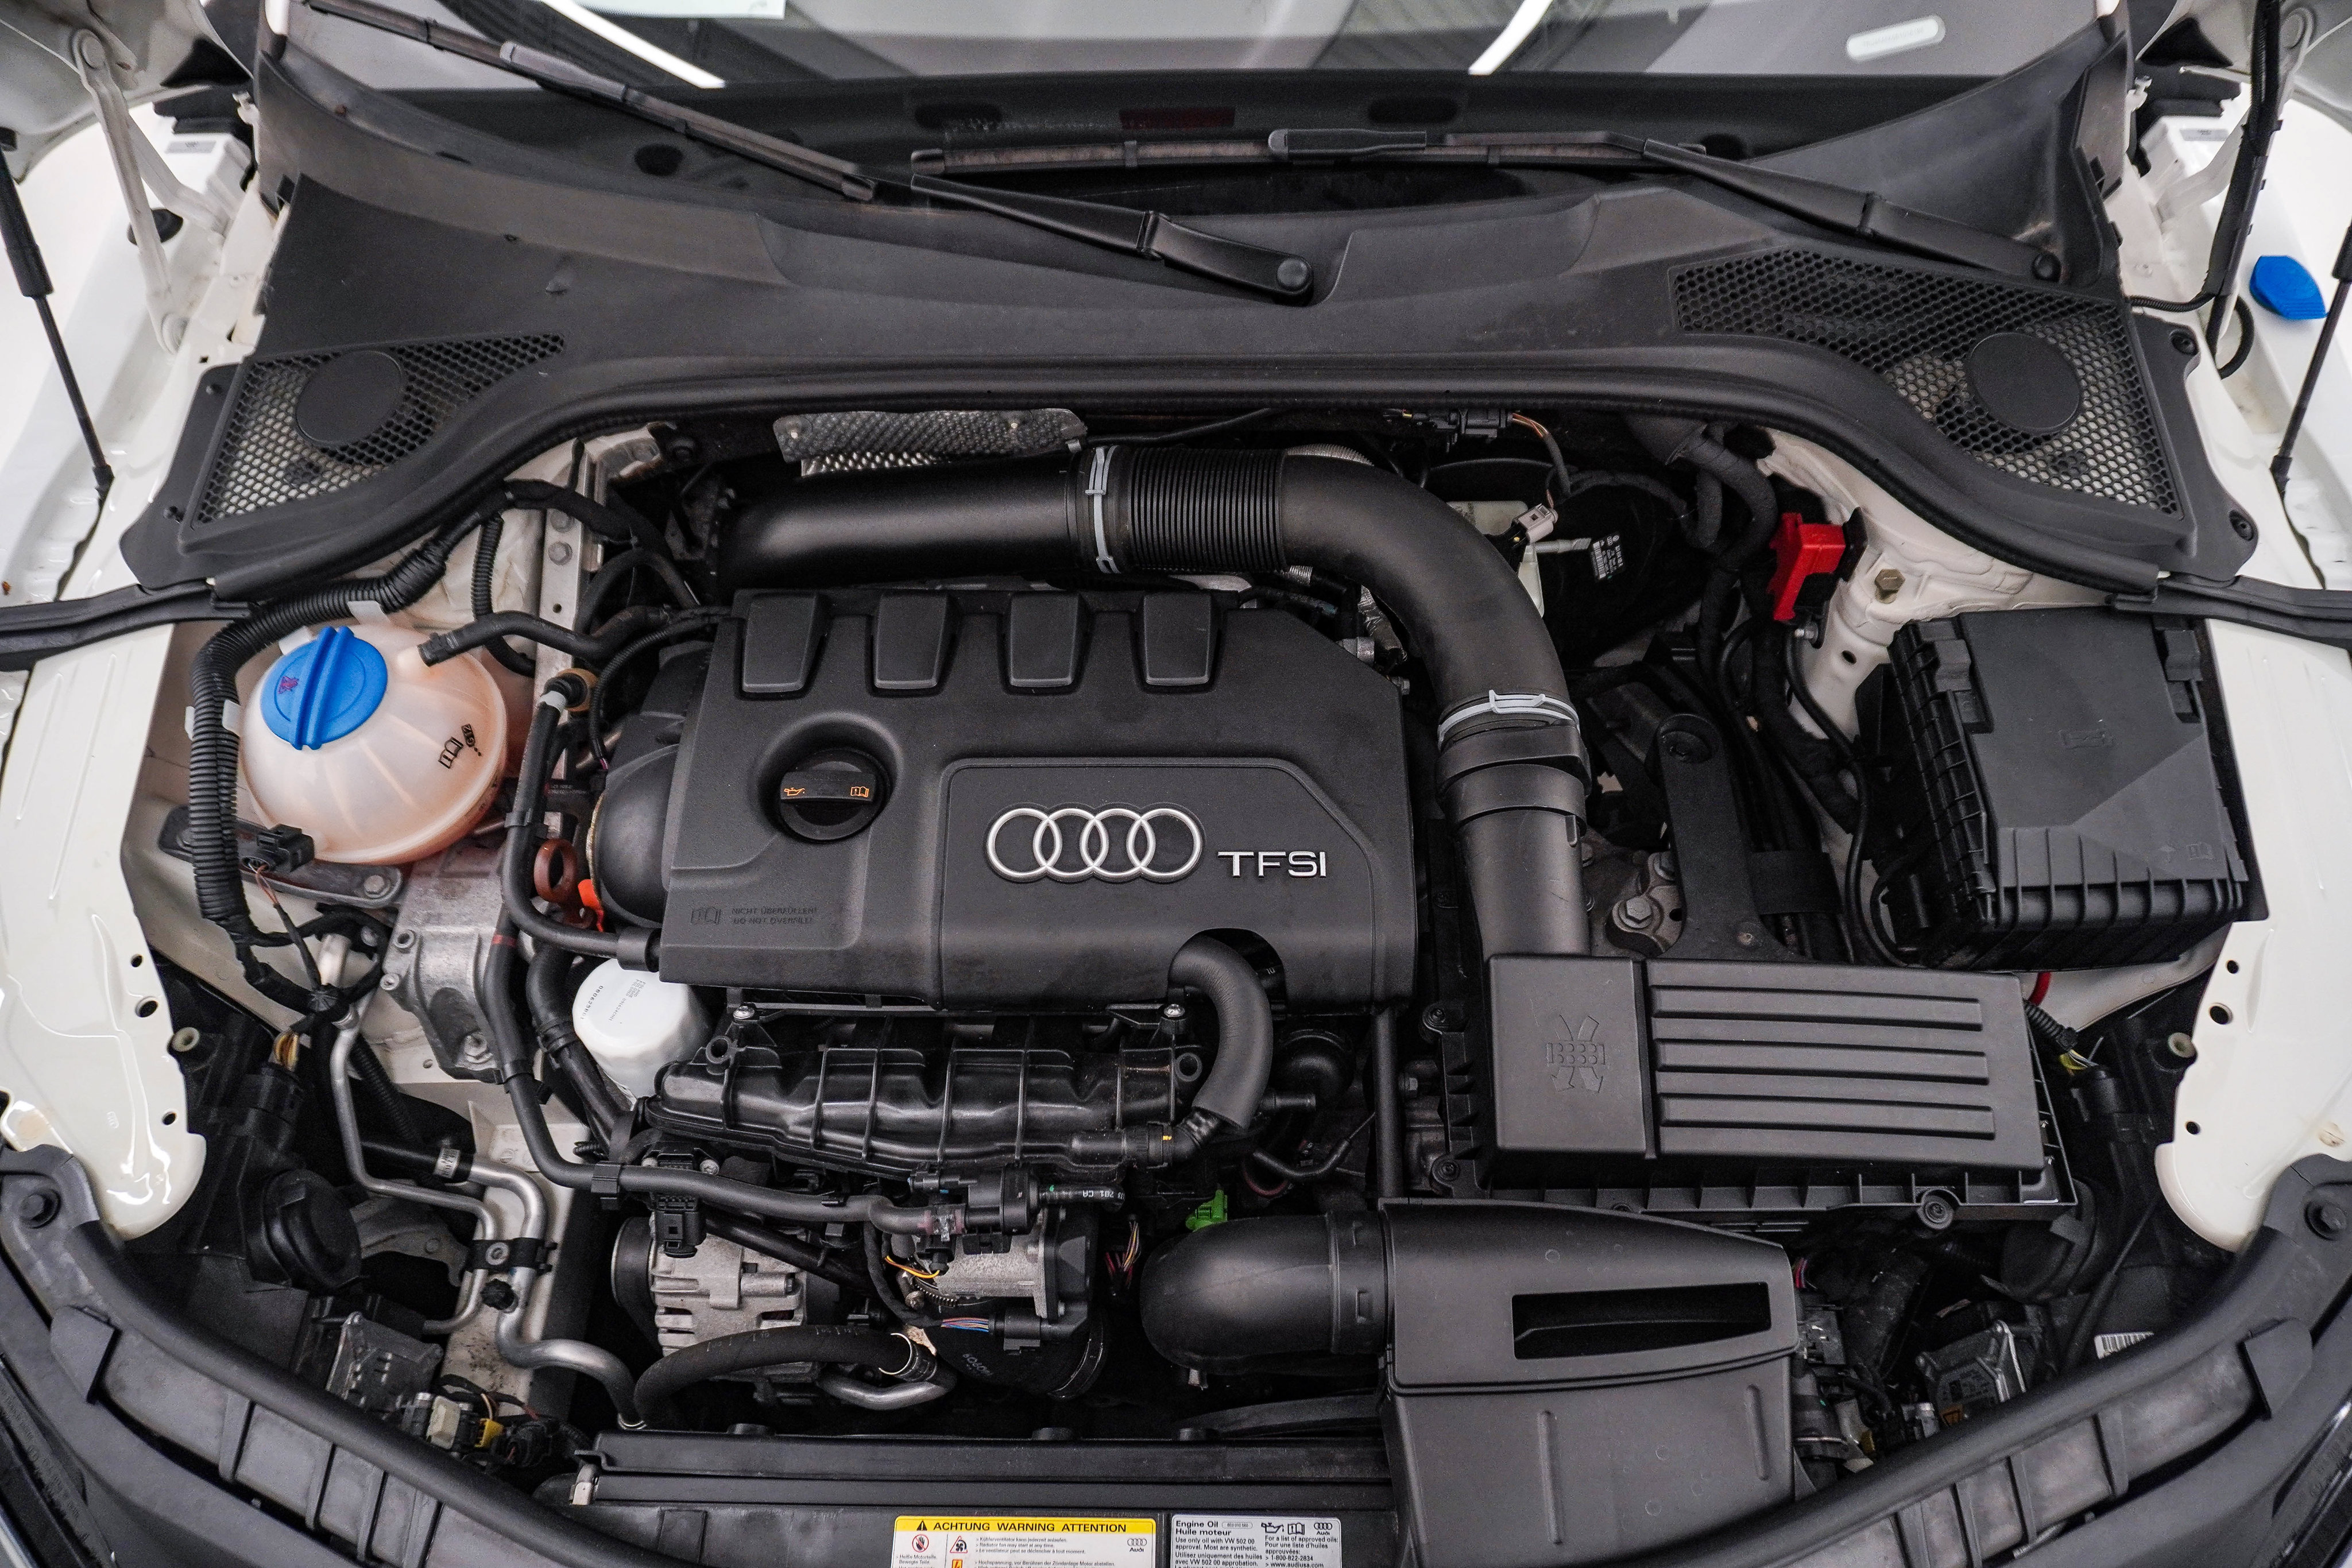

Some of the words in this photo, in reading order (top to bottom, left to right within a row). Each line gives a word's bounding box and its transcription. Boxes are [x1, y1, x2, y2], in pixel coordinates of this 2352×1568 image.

[1217, 851, 1326, 877] TFSI
[933, 1523, 990, 1531] ACHTUNG
[997, 1523, 1055, 1531] WARNING
[1062, 1523, 1126, 1532] ATTENTION
[1176, 1520, 1204, 1529] Engine
